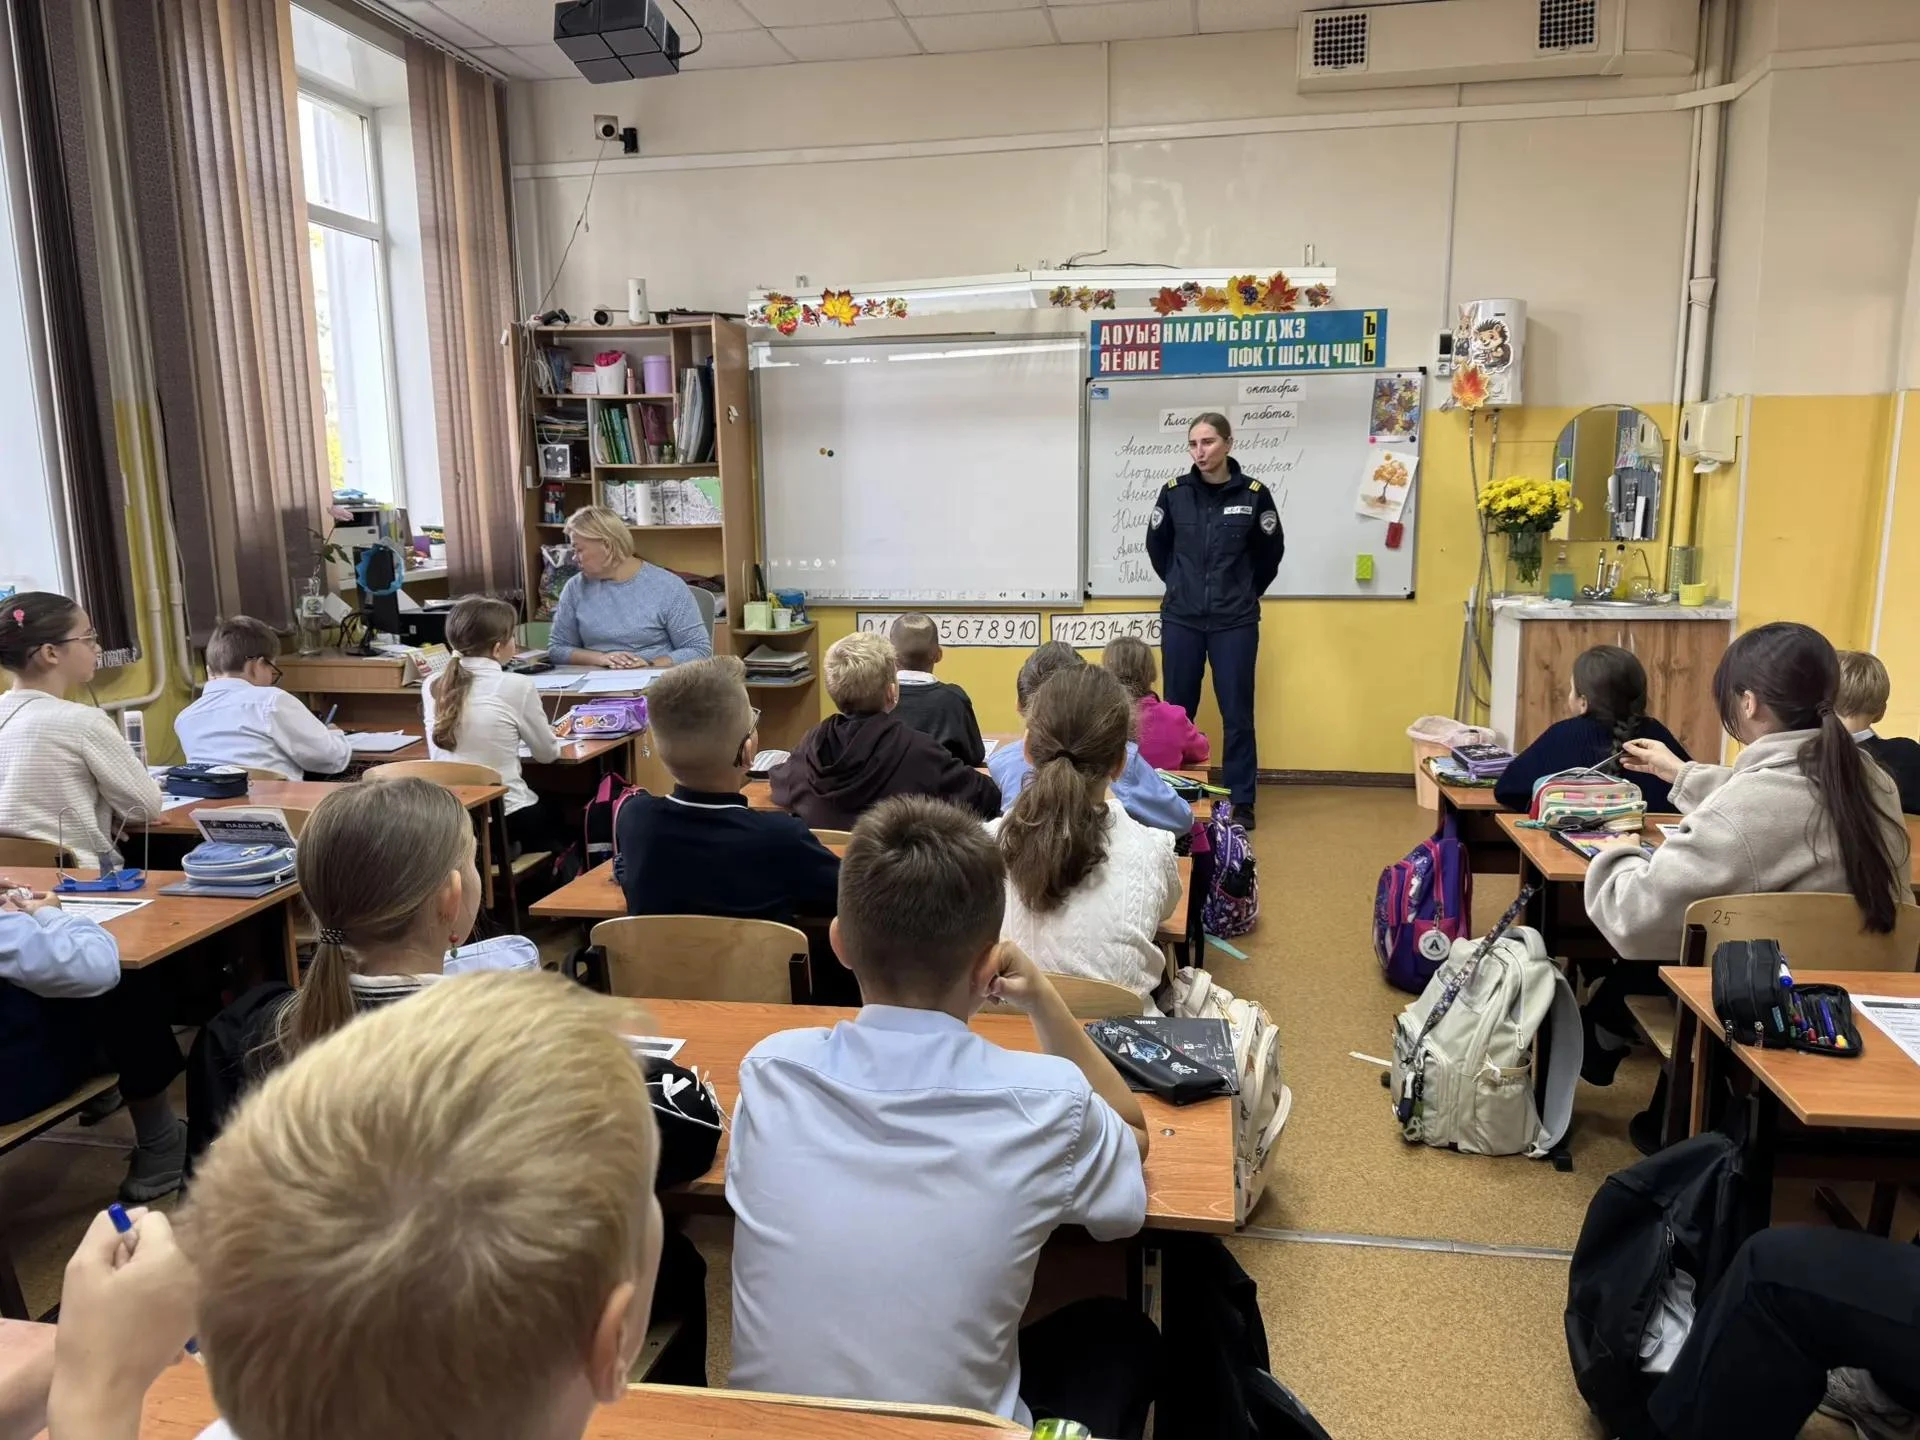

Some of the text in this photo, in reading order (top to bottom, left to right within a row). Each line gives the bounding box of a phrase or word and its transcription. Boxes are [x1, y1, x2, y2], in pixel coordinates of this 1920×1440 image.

[1246, 378, 1300, 398] октября
[1241, 404, 1296, 425] работа.
[1711, 909, 1737, 926] 25
